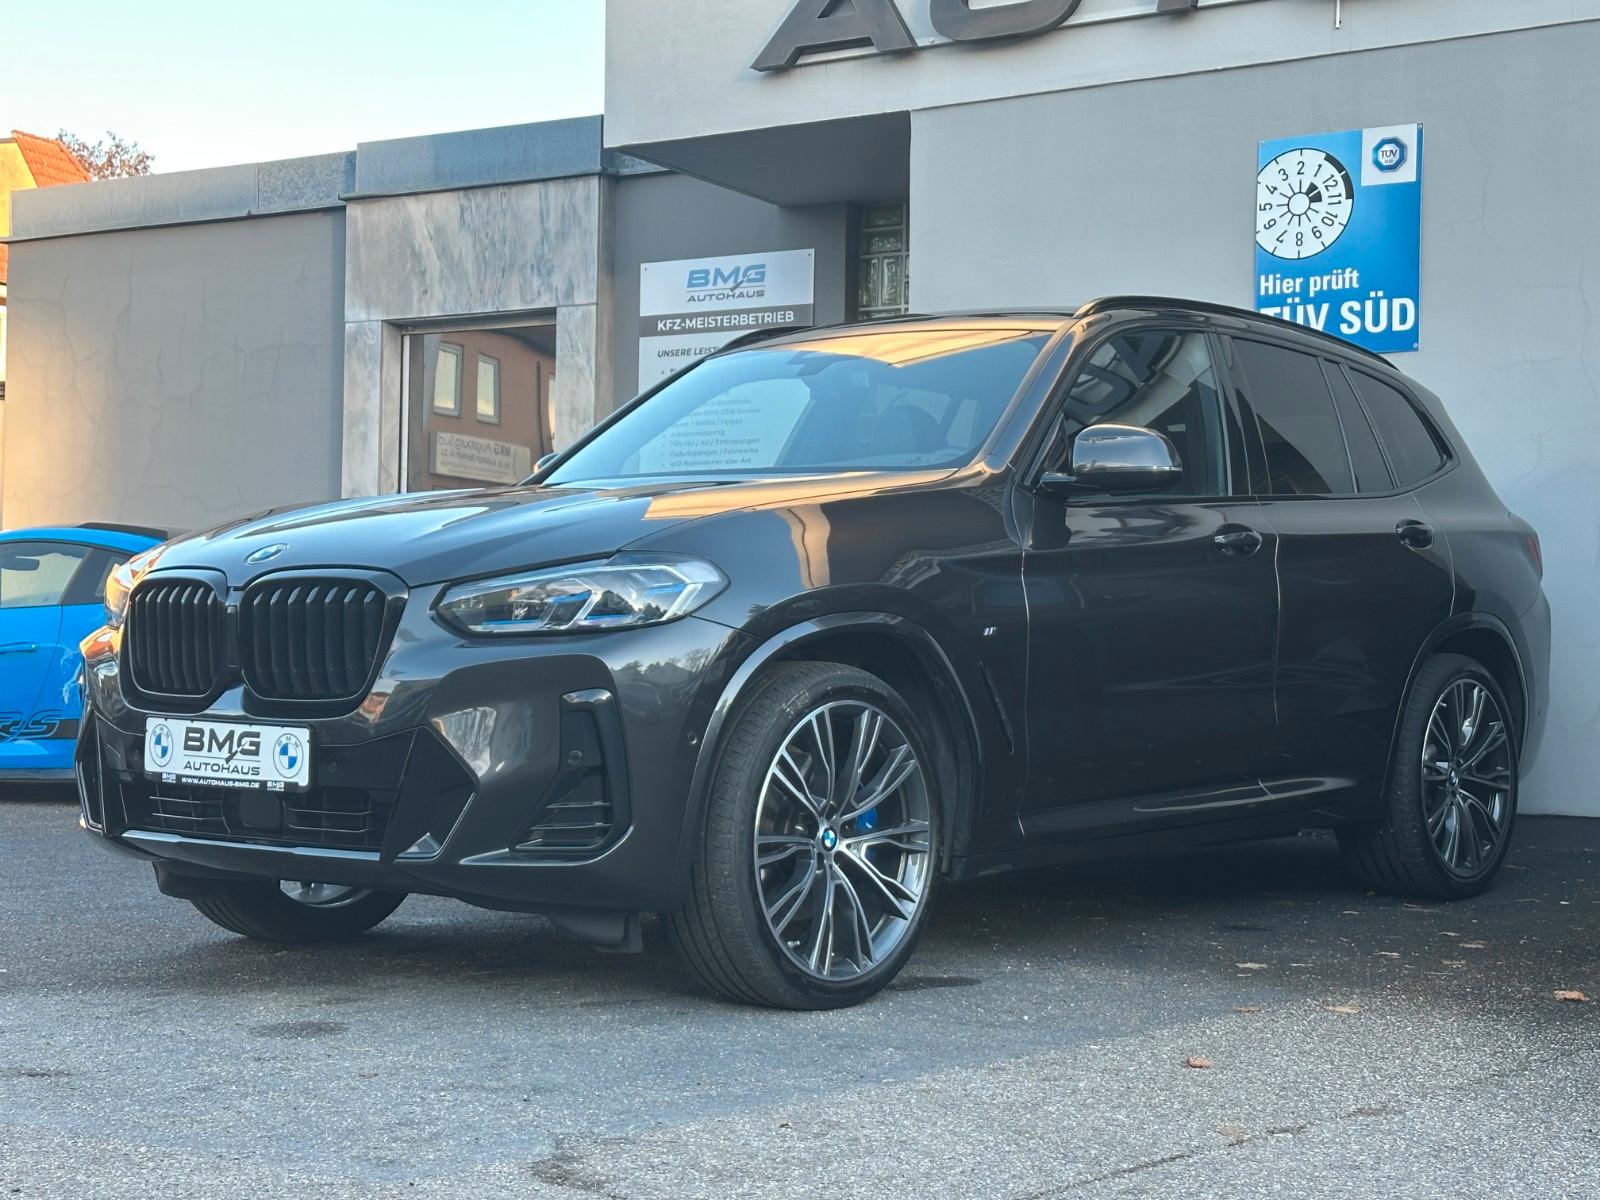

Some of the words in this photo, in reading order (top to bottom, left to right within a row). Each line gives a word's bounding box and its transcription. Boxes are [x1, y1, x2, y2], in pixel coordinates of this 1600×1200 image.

[1278, 168, 1289, 181] 3
[1297, 161, 1305, 175] 2
[1314, 164, 1322, 177] 1
[1266, 184, 1278, 195] 4
[1323, 174, 1338, 192] 12
[1259, 202, 1272, 211] 5
[1327, 193, 1342, 206] 11
[1321, 211, 1338, 227] 10
[1276, 230, 1288, 244] 7
[1295, 231, 1303, 247] 8
[686, 263, 766, 289] BMG
[1260, 273, 1304, 296] Hier
[1309, 267, 1360, 298] prüft
[687, 289, 765, 303] AUTOHAUS
[1339, 290, 1415, 335] SÜD
[657, 310, 794, 332] KFZ-MEISTERBETRIEB
[657, 348, 692, 358] UNSERE
[693, 346, 720, 356] LEIST
[183, 726, 261, 757] BMG
[184, 760, 261, 776] AUTOHAUS
